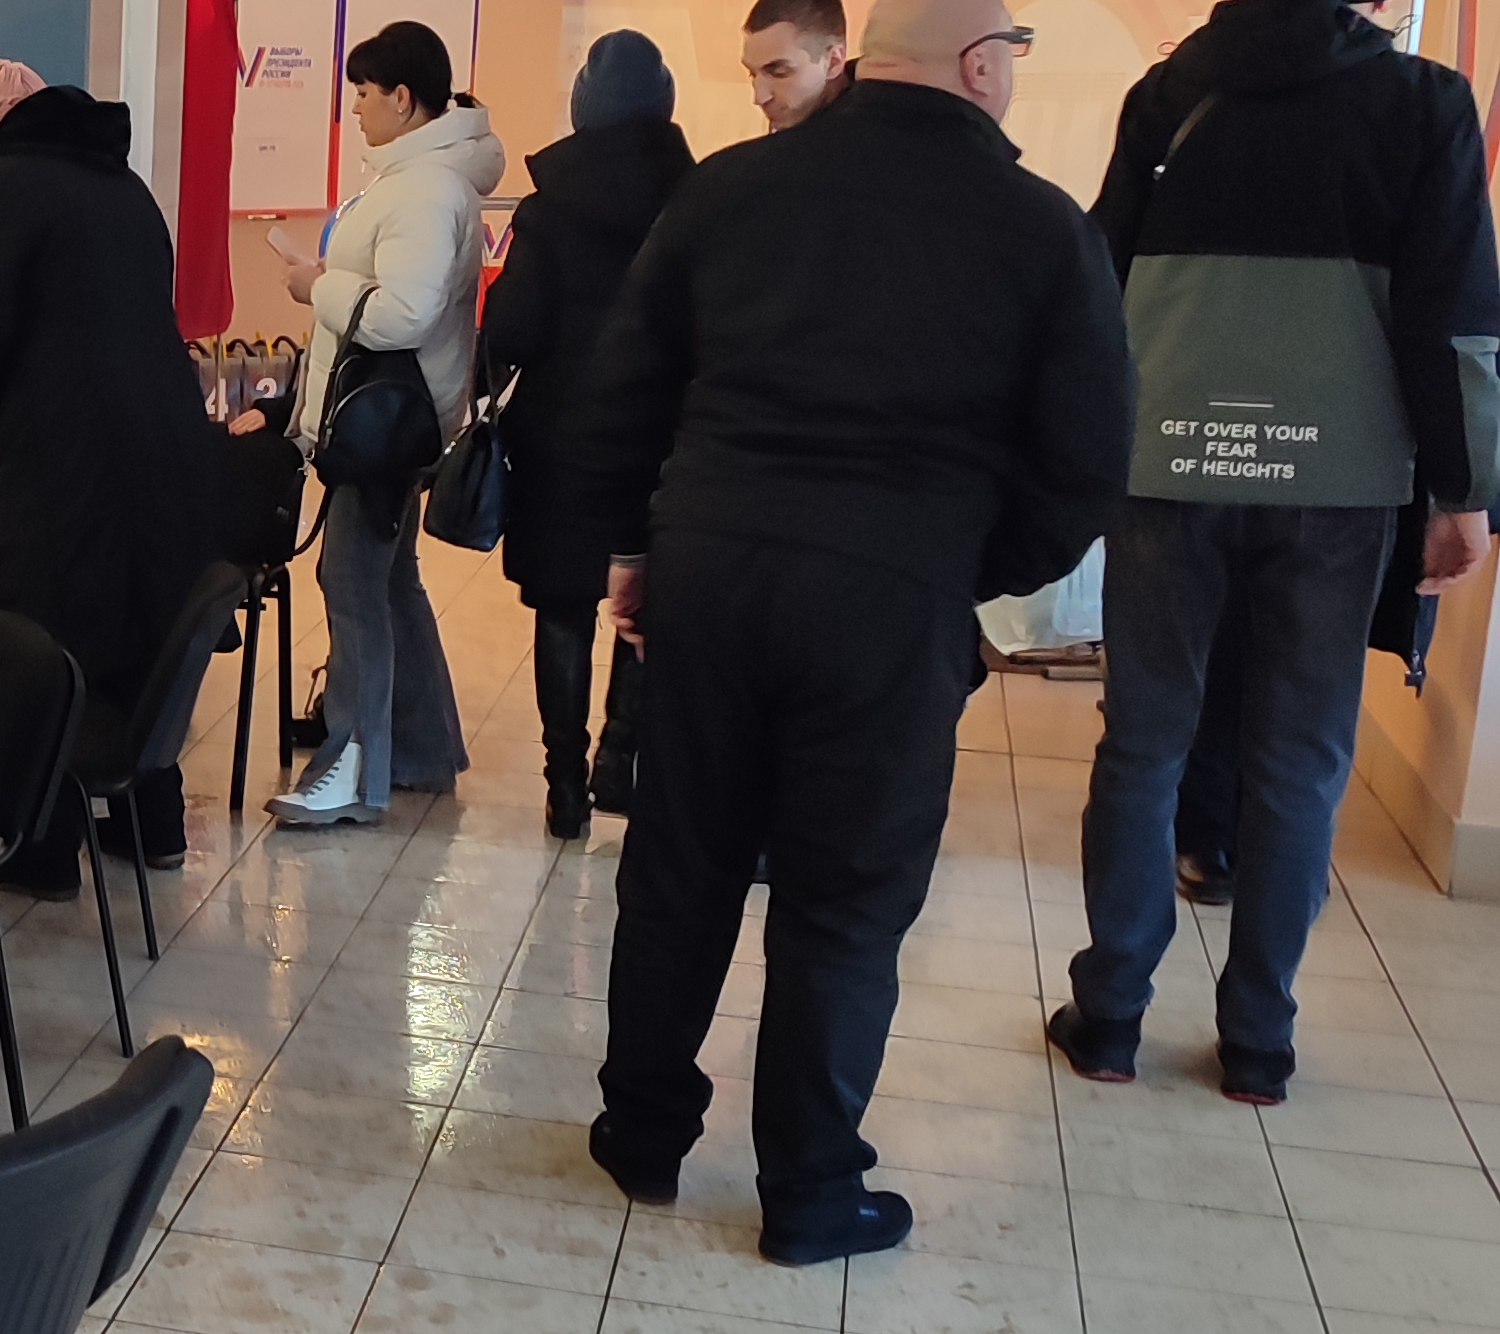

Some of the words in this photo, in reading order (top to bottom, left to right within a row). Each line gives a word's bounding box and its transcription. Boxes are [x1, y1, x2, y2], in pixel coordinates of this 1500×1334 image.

[205, 378, 228, 422] 4
[1160, 419, 1199, 436] GET
[1203, 422, 1258, 439] OVER
[1263, 424, 1319, 442] YOUR
[1205, 441, 1258, 458] FEAR
[1170, 458, 1198, 474] OF
[1202, 460, 1296, 479] HEUGHTS
